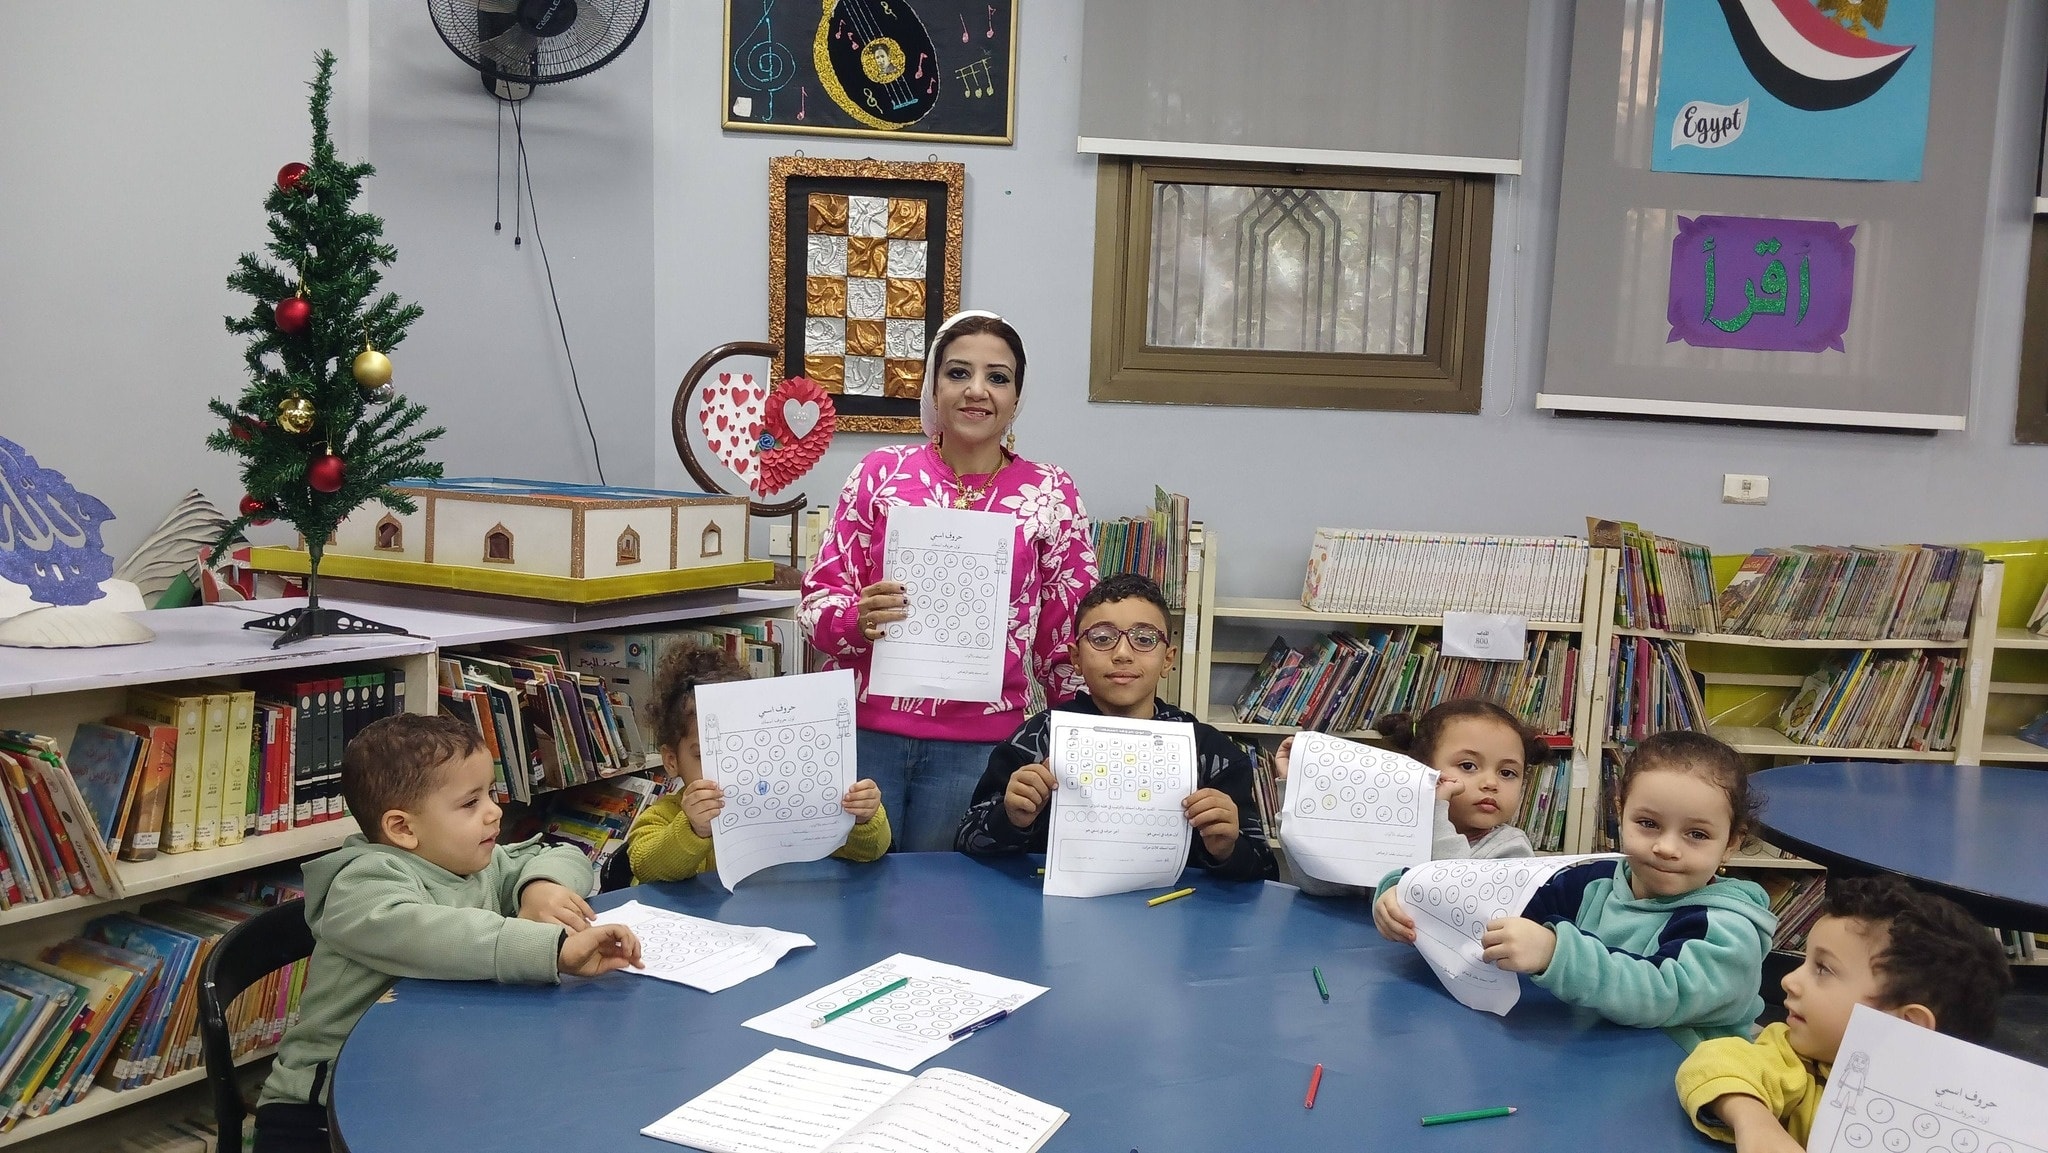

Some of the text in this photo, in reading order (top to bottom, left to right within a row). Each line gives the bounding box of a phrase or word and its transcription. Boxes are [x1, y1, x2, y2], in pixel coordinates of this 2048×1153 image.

[1683, 105, 1742, 145] Egypt
[945, 533, 963, 541] حروف
[758, 705, 796, 718] حروف اسمي
[1935, 1087, 1999, 1109] حروف اسمي
